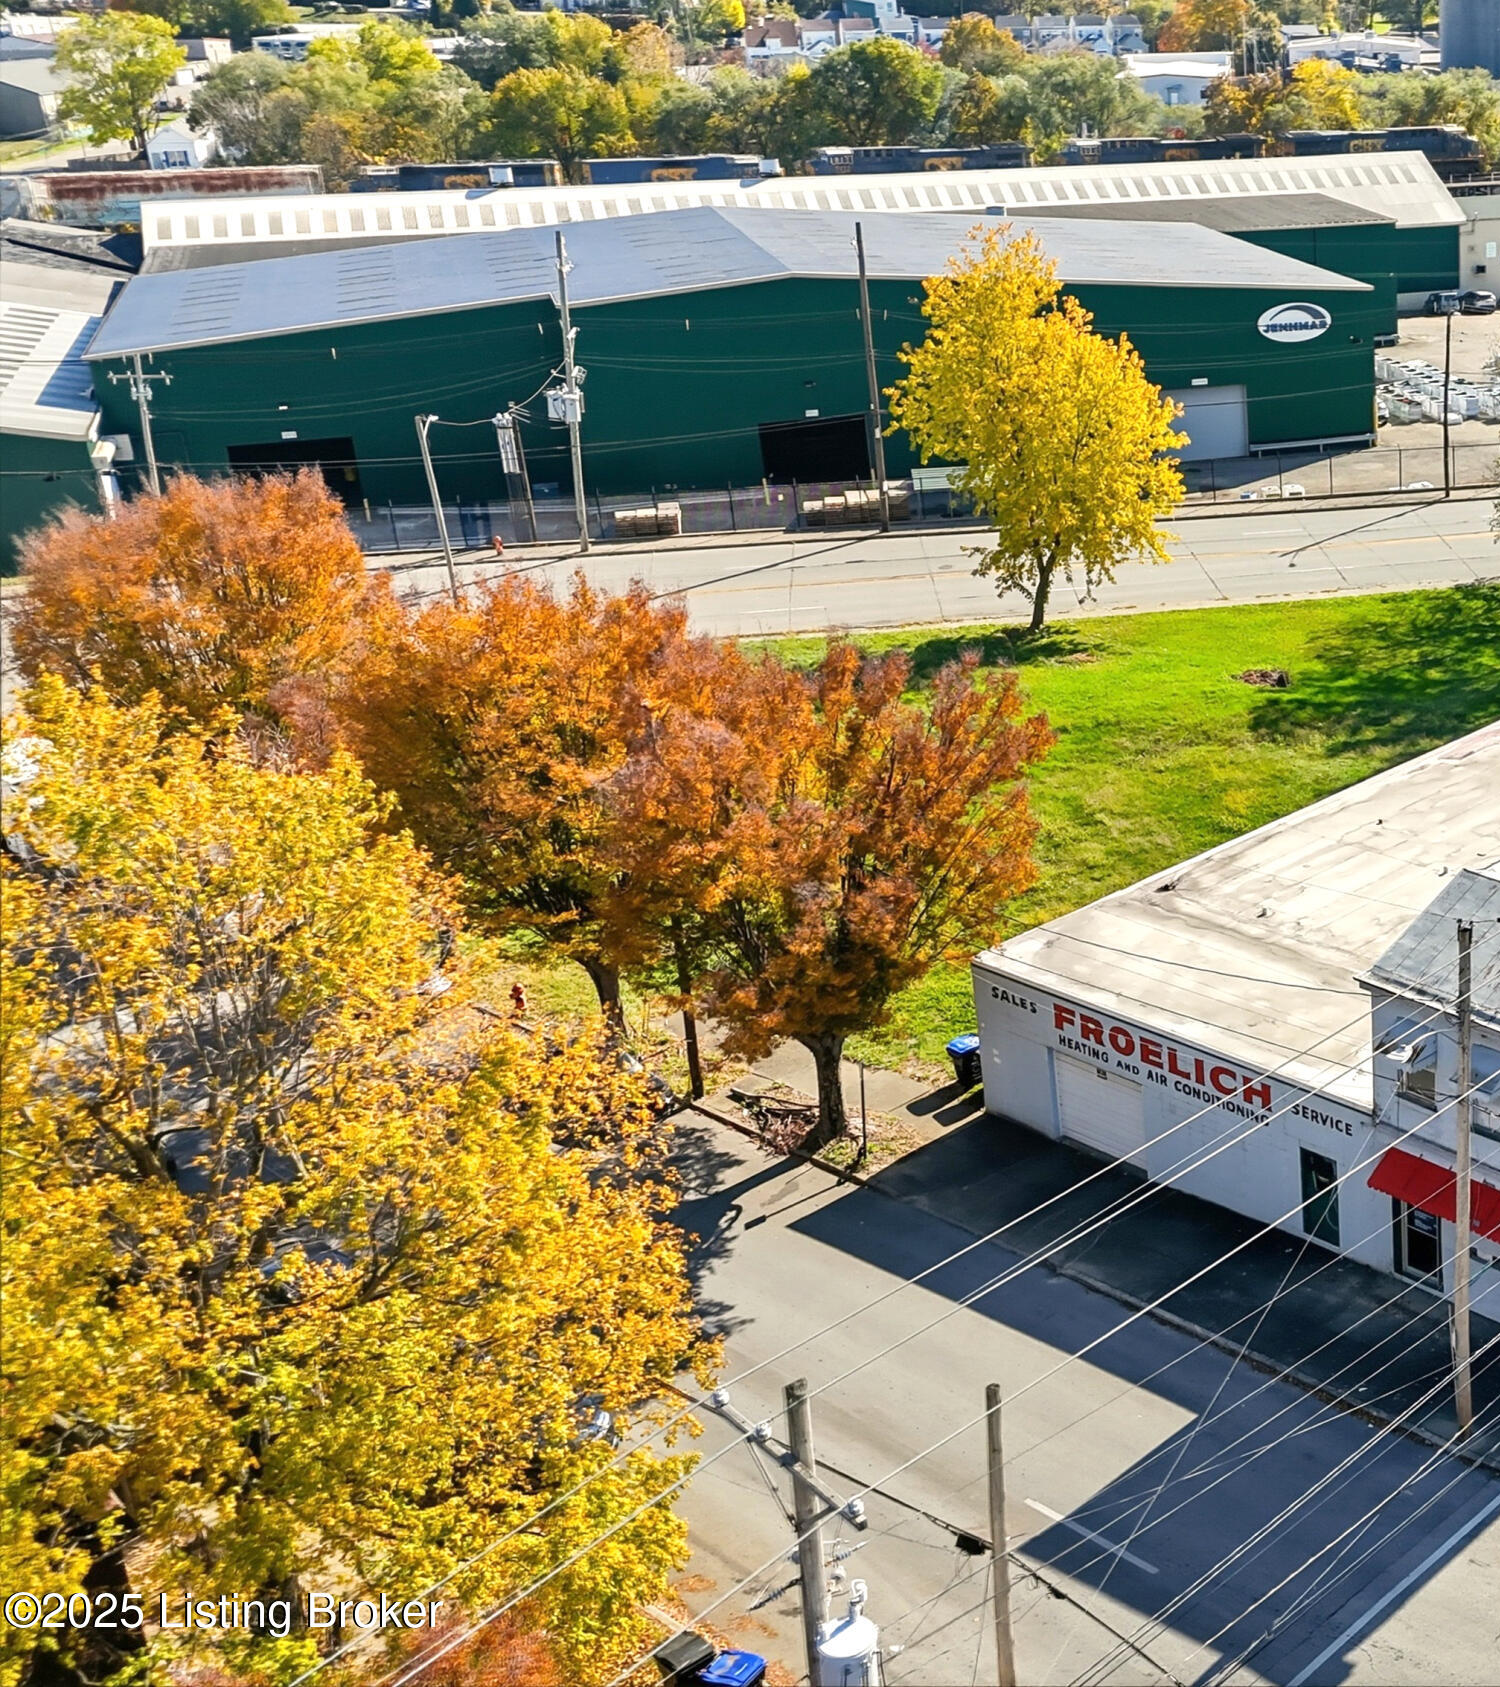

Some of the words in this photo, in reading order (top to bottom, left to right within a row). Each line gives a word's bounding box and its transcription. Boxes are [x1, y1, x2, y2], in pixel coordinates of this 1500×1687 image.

[992, 986, 1037, 1014] SALES
[1053, 1002, 1273, 1113] FROELICH
[1058, 1034, 1109, 1063] HEATING
[1116, 1060, 1140, 1076] AND
[1146, 1069, 1168, 1087] AIR
[1174, 1080, 1270, 1127] CONDITIONING
[1290, 1103, 1353, 1137] SERVICE
